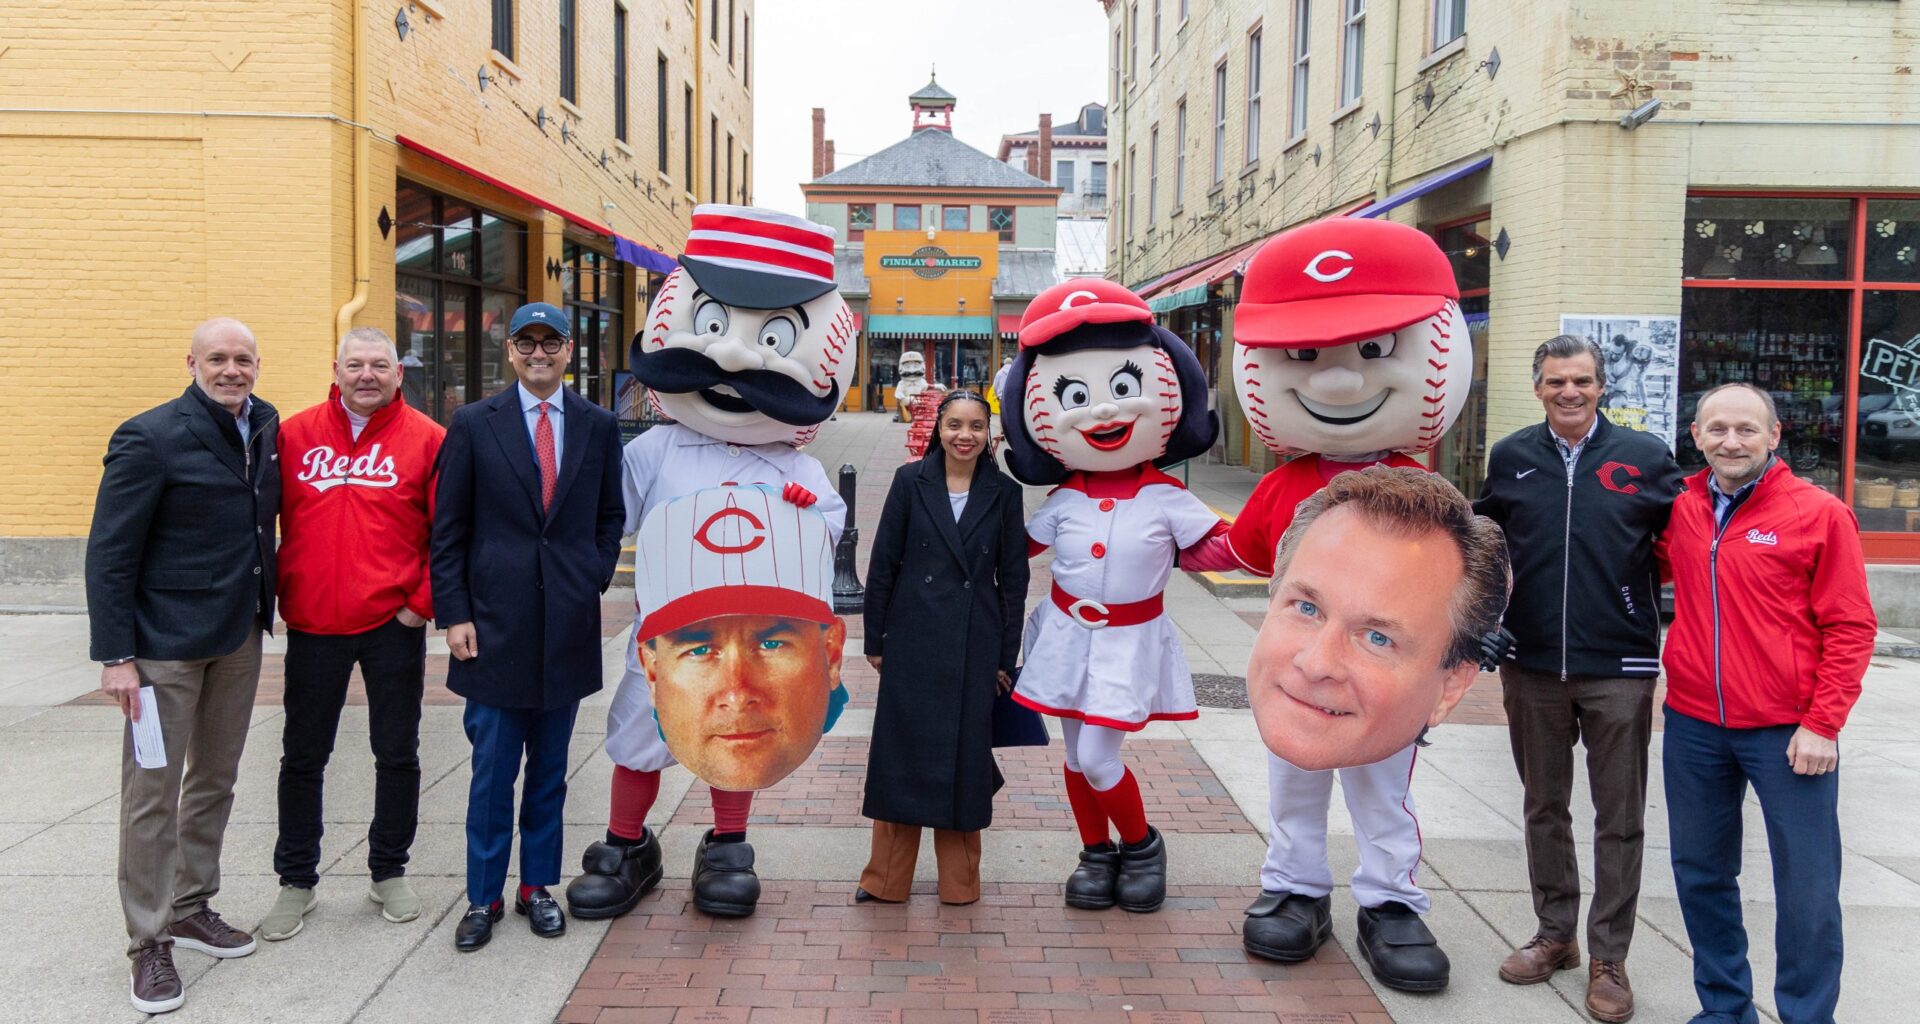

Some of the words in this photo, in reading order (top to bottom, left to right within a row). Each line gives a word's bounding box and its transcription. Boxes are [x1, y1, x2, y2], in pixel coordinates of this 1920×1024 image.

[451, 251, 466, 270] 116
[883, 258, 926, 266] FINDLAY
[936, 259, 980, 267] MARKET
[1302, 249, 1354, 282] C
[1872, 346, 1920, 385] PET
[297, 443, 399, 493] Reds
[693, 507, 766, 554] C
[1745, 528, 1777, 546] Reds
[1068, 599, 1110, 630] C
[1621, 585, 1636, 615] CINCY
